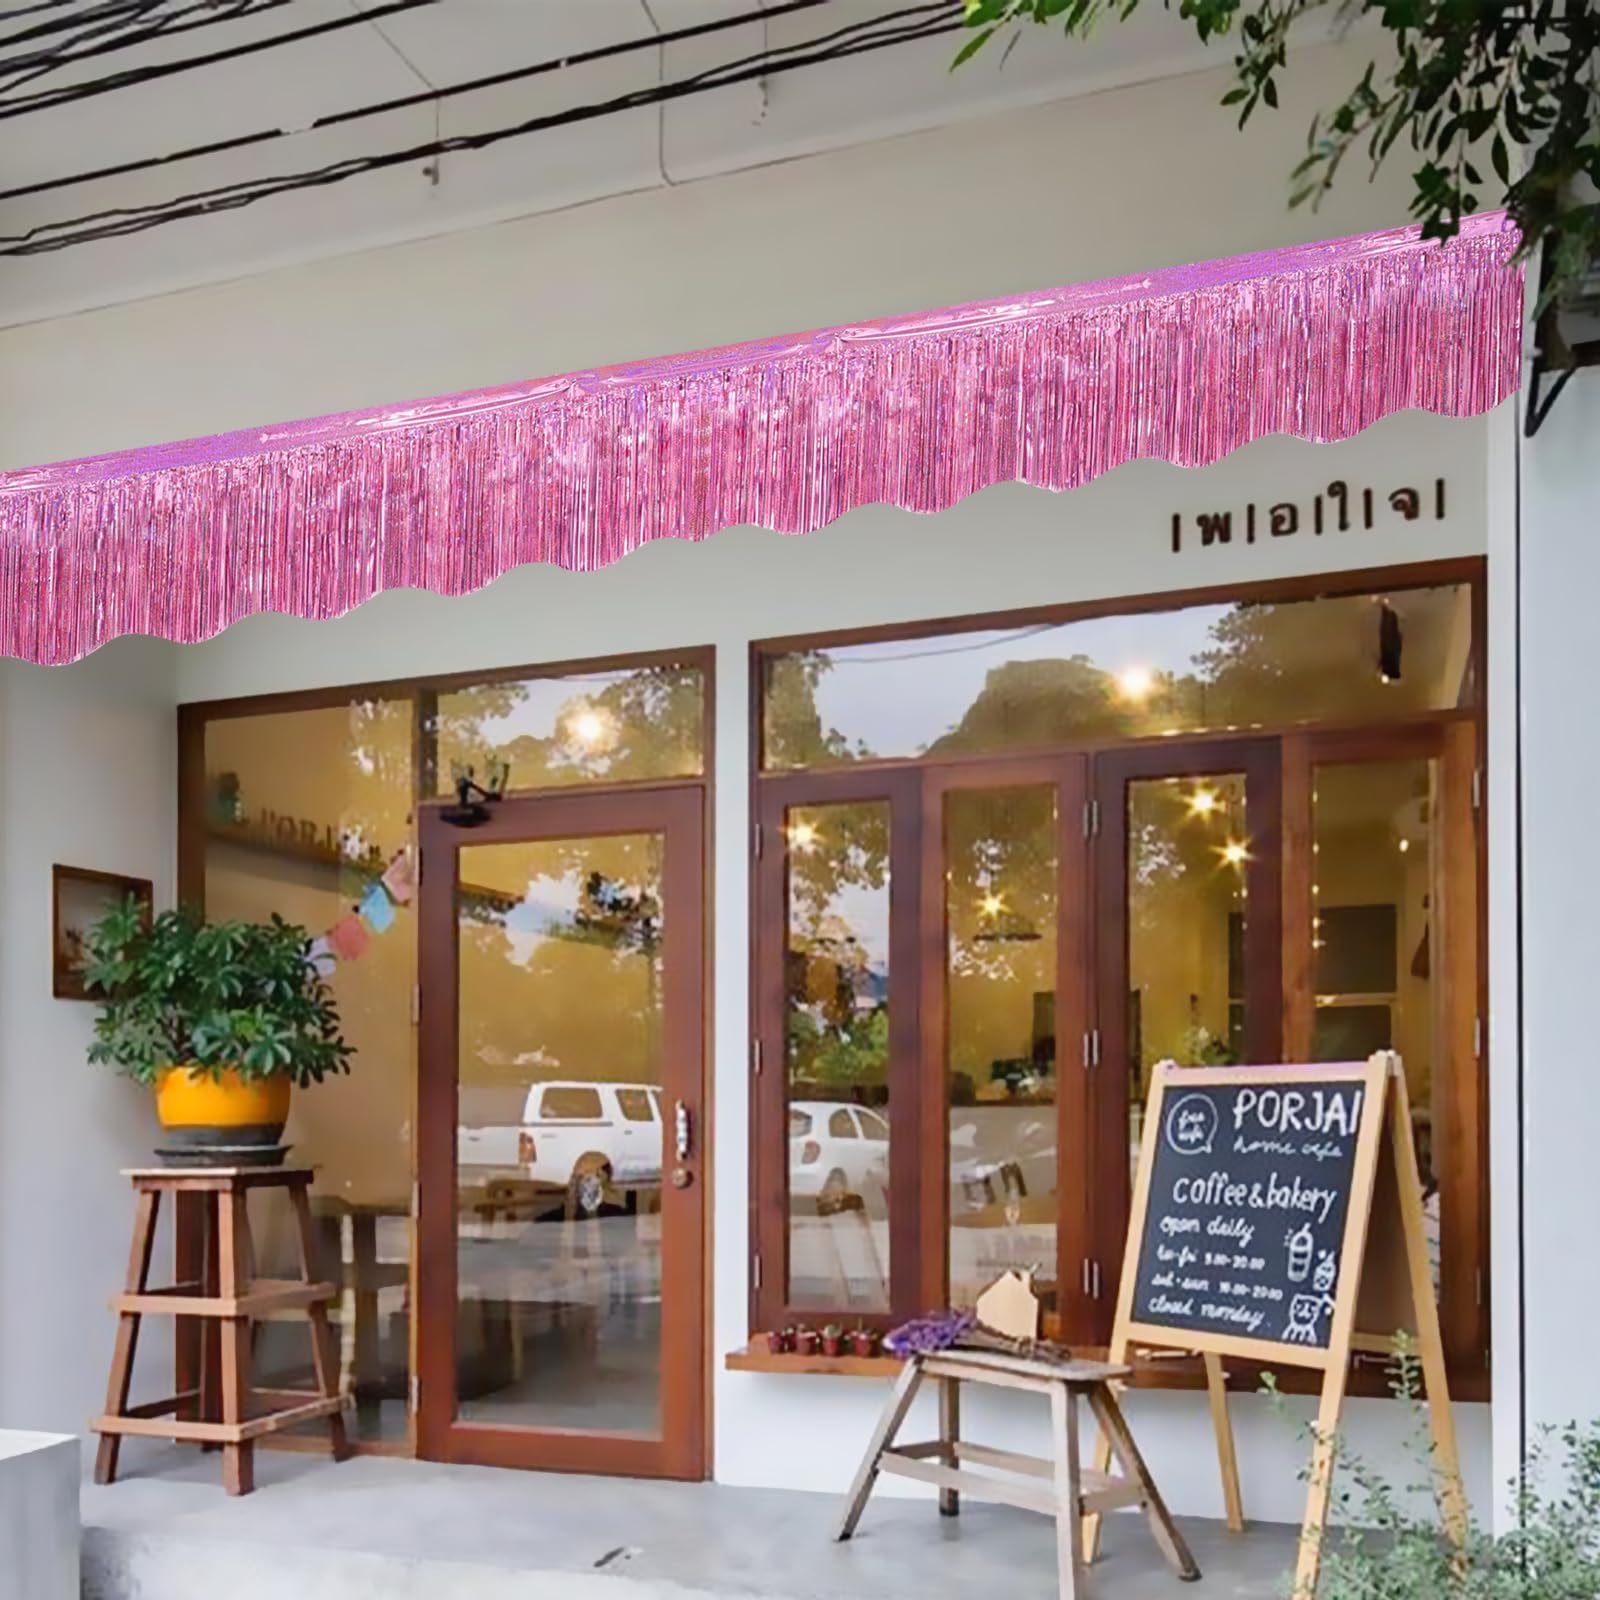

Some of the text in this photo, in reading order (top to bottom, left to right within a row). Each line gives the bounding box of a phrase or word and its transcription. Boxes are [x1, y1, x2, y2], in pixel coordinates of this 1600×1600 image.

[1233, 1088, 1363, 1137] PORJAI
[1233, 1136, 1296, 1156] home
[1159, 1215, 1254, 1248] open daily
[1201, 1302, 1265, 1332] monday
